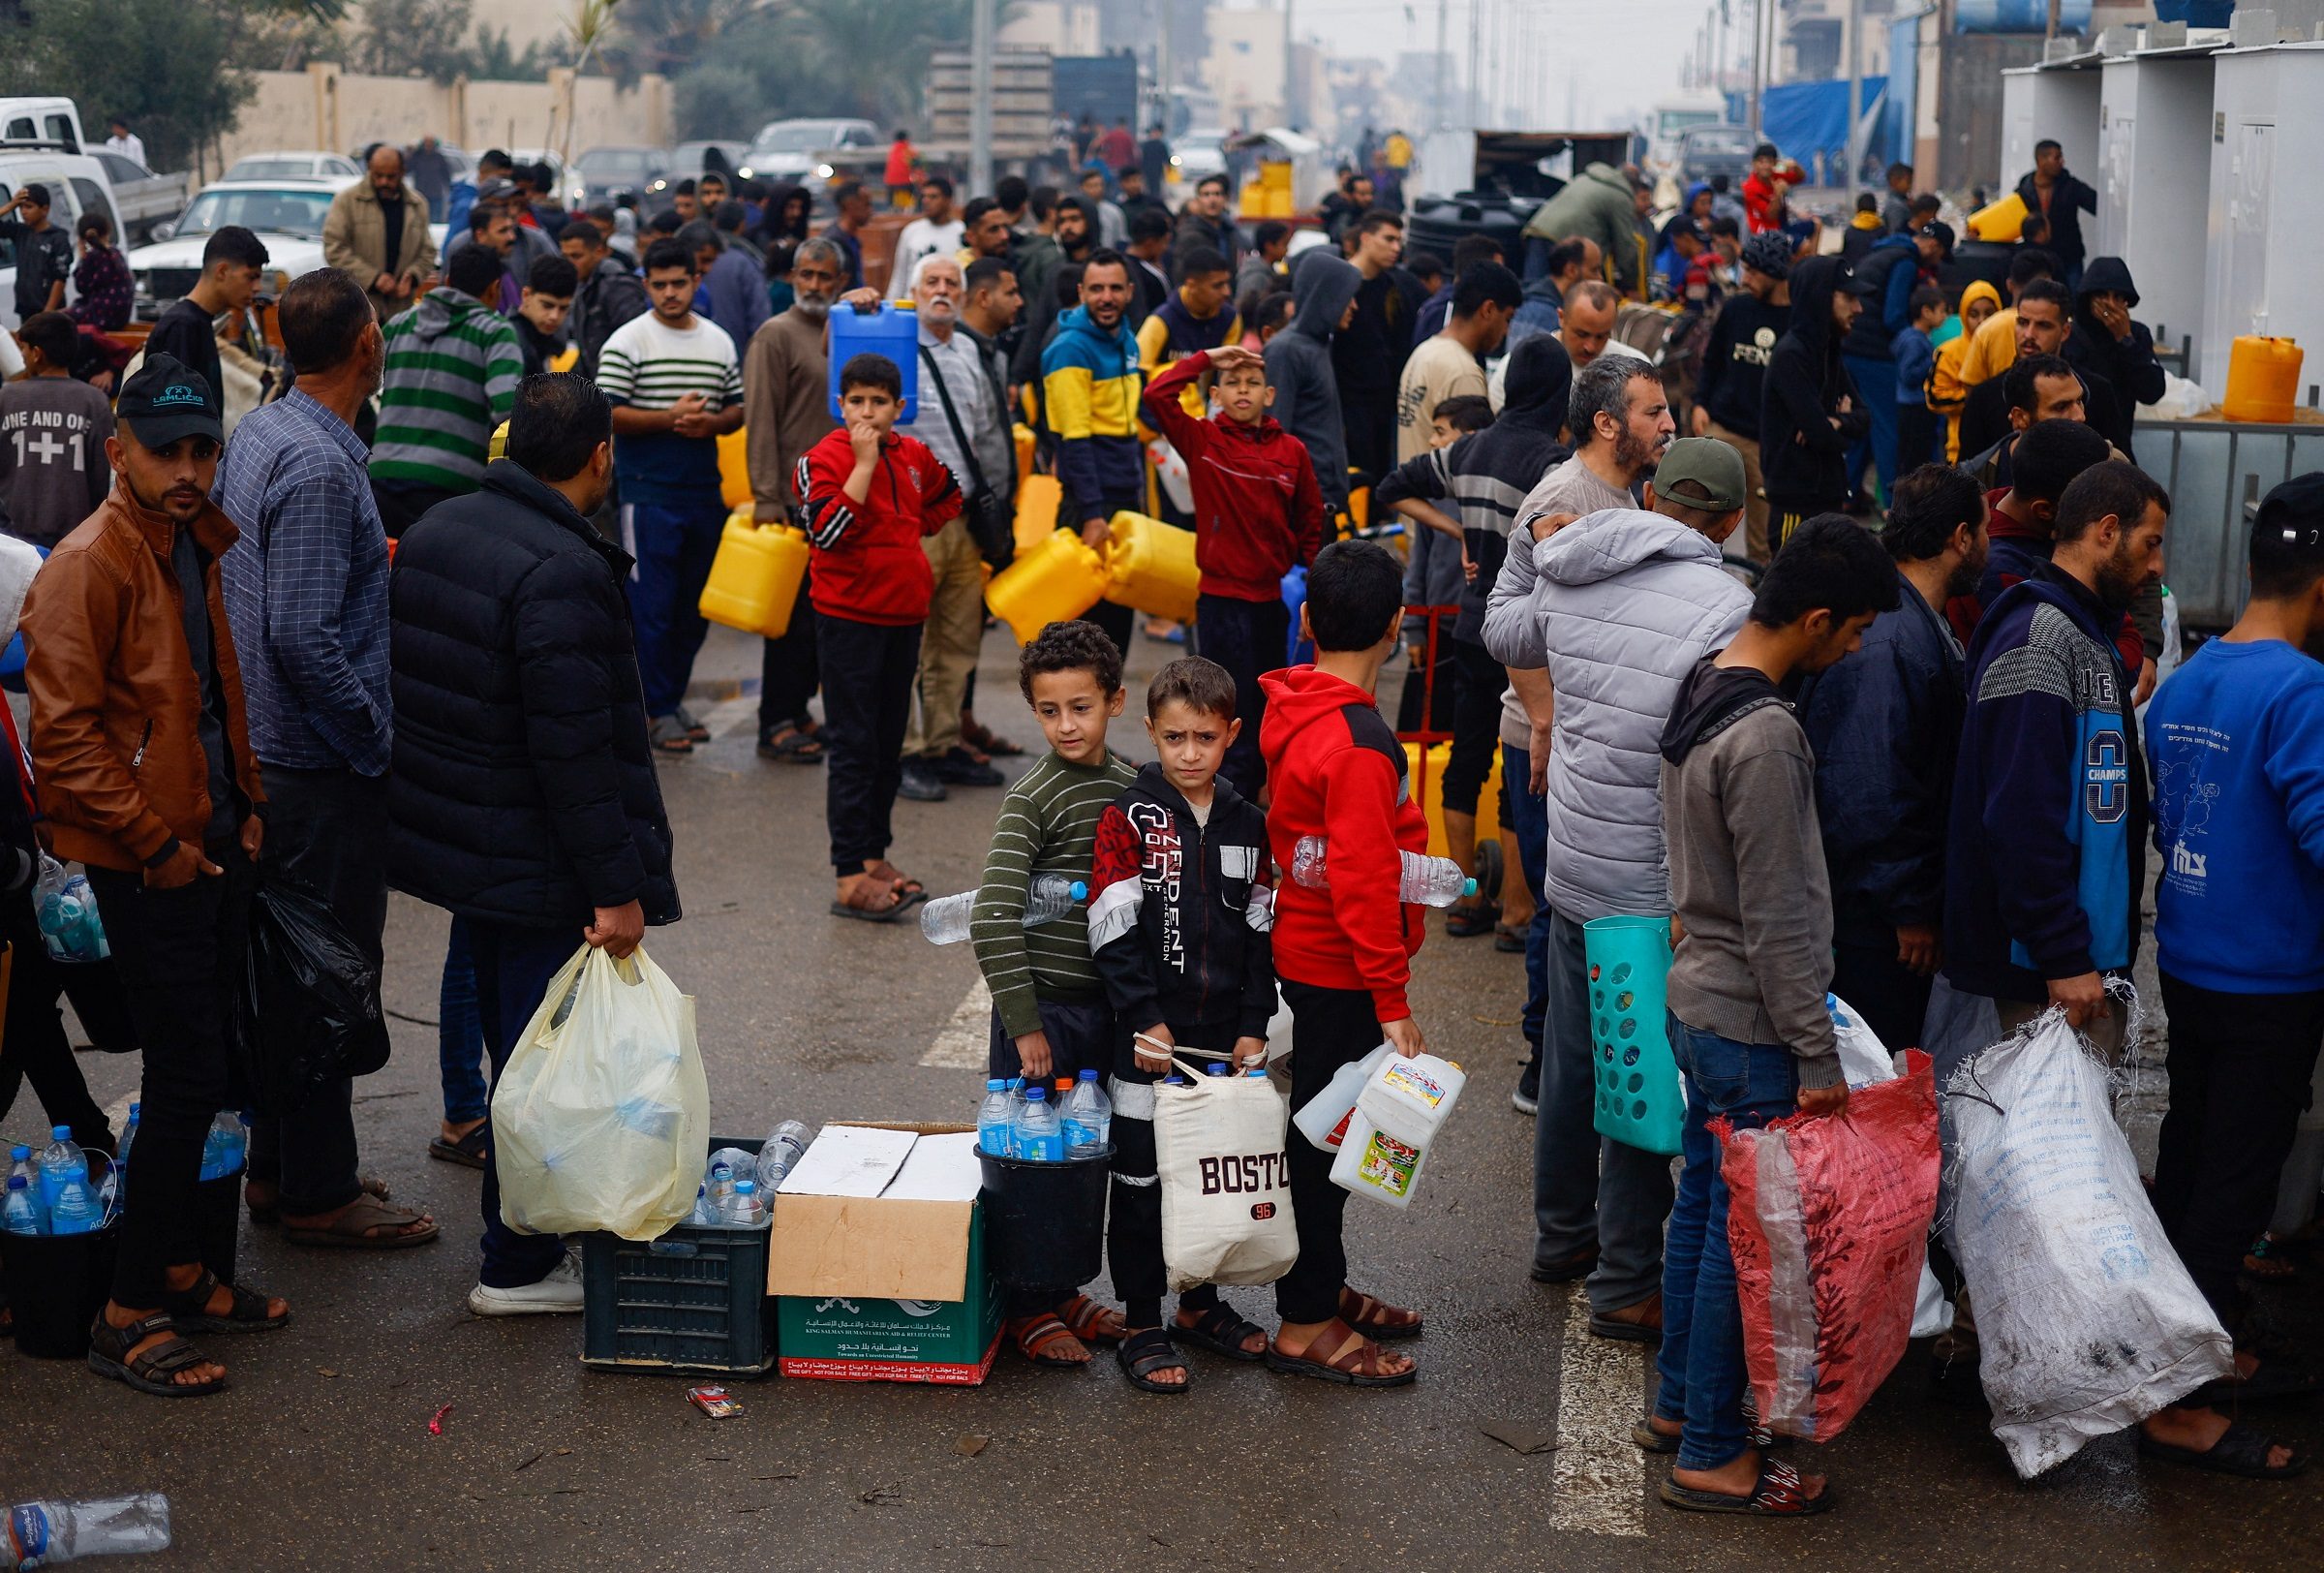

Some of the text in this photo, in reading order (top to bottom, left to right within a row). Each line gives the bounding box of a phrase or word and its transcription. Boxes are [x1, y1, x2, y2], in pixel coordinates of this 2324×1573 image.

[2, 411, 27, 430] ONE
[32, 411, 62, 428] AND
[2088, 769, 2126, 781] CHAMPS
[1199, 1150, 1291, 1195] BOSTO
[1256, 1204, 1270, 1219] 96
[860, 1342, 869, 1352] بلا
[902, 1344, 919, 1353] نحو
